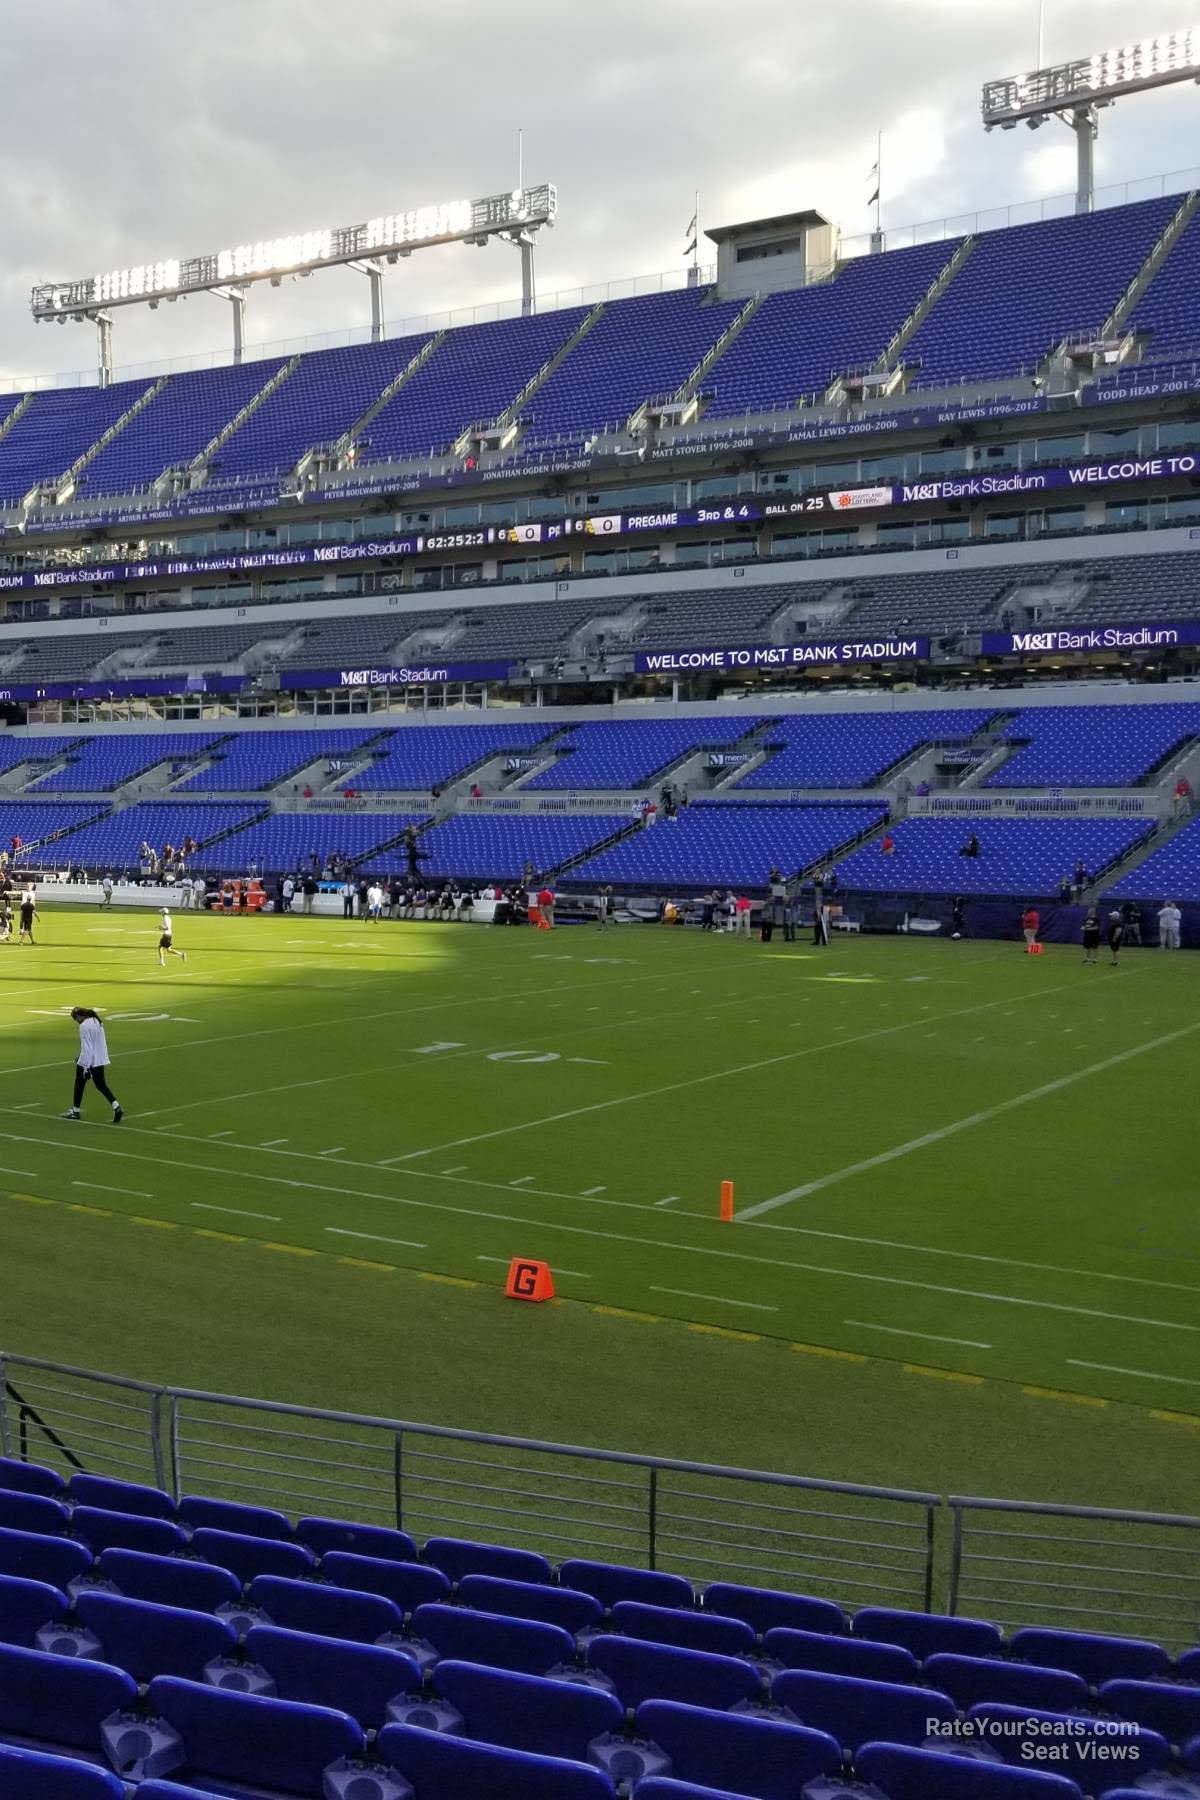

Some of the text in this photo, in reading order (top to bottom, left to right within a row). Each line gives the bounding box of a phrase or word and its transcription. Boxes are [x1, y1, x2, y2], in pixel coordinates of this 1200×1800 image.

[1097, 389, 1126, 400] TODD
[1130, 385, 1158, 397] HEAP
[938, 401, 1038, 423] RAY LEWIS 1996-2012
[788, 421, 897, 442] JAMAL LEWIS 2000-2006
[652, 439, 753, 458] MATT STOVER 1996-2008
[483, 460, 591, 480] JONATHAN OGDEN 1996-2007
[1069, 457, 1194, 483] WELCOME TO
[324, 491, 344, 499] PETER
[345, 487, 382, 497] BOULWARE
[903, 474, 1044, 501] M&T Bank Stadium
[189, 507, 214, 515] MICHAEL
[697, 505, 749, 522] 3RD & 4
[766, 497, 824, 514] BALL ON 25
[150, 511, 172, 519] MODELL
[628, 513, 677, 528] PREGAME
[427, 533, 484, 548] 62:252:2
[313, 542, 410, 560] M&T Bank Stadium
[34, 573, 57, 585] M&T
[57, 571, 77, 583] Bank
[78, 569, 114, 581] Stadium
[1012, 628, 1177, 651] M&T Bank Stadium
[647, 641, 917, 669] WELCOME TO M&T BANK STADIUM
[341, 668, 447, 685] M&T Bank Stadium
[513, 1263, 538, 1296] G
